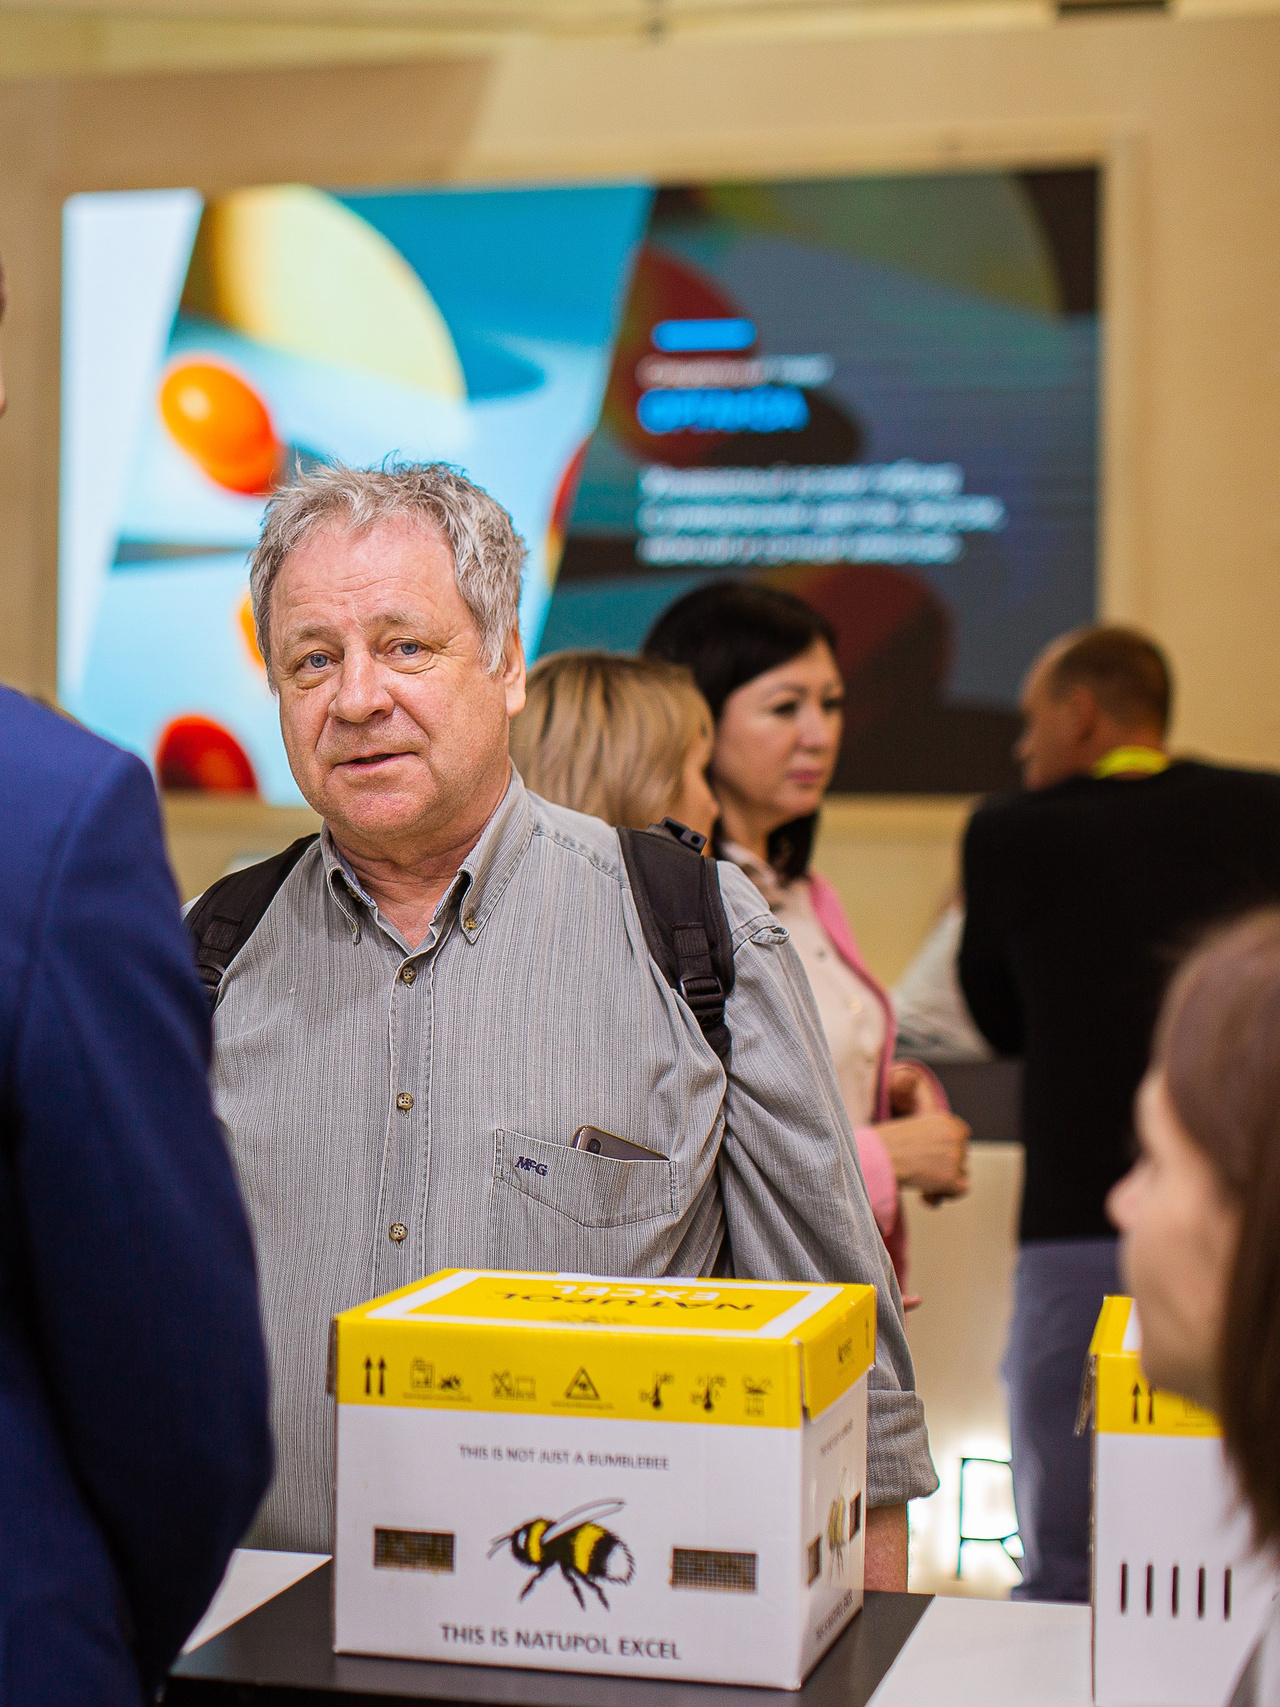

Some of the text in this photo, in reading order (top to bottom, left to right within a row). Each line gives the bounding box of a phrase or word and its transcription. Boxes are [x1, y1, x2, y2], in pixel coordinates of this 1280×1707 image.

[495, 1291, 756, 1310] NATUPOL
[552, 1284, 721, 1301] EXCEL
[459, 1444, 670, 1471] THIS IS NOT JUST A BUMBLEBEE
[440, 1623, 681, 1660] THIS IS NATUPOL EXCEL
